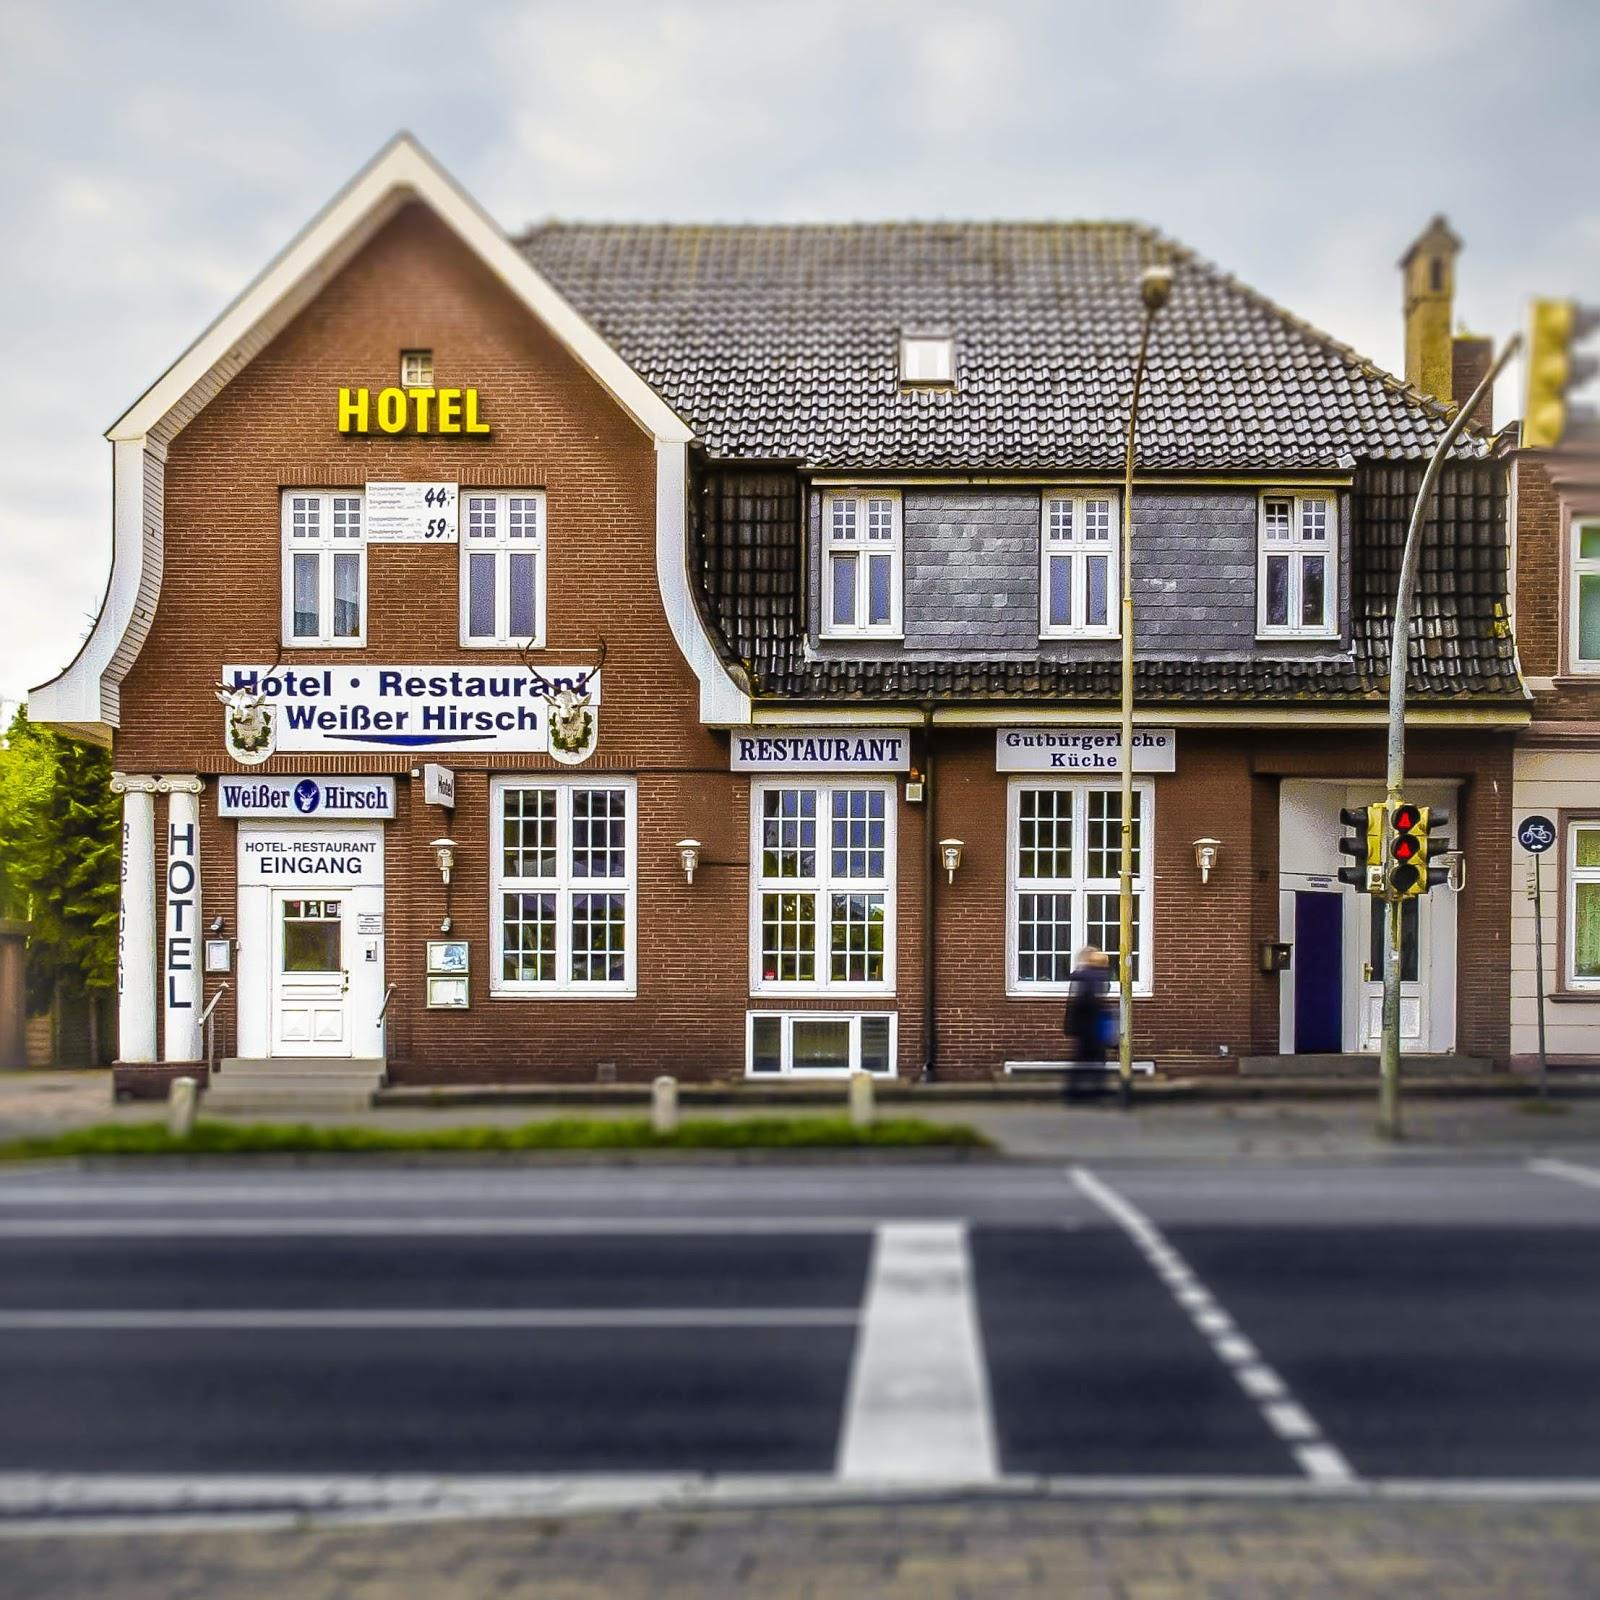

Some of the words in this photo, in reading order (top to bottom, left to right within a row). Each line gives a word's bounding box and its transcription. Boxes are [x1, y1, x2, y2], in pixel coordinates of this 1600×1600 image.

[338, 387, 490, 433] HOTEL
[234, 671, 332, 697] Hotel
[379, 671, 590, 697] Restaurant
[286, 705, 409, 730] Weißer
[423, 705, 537, 730] Hirsch
[739, 738, 902, 762] RESTAURANT
[1006, 733, 1167, 750] Gutbürgerlche
[1050, 752, 1118, 767] Küche
[223, 785, 290, 809] Weißer
[324, 786, 388, 809] Hirsch
[245, 842, 376, 853] HOTEL-RESTAURANT
[260, 856, 362, 874] EINGANG
[168, 823, 195, 1009] HOTEL
